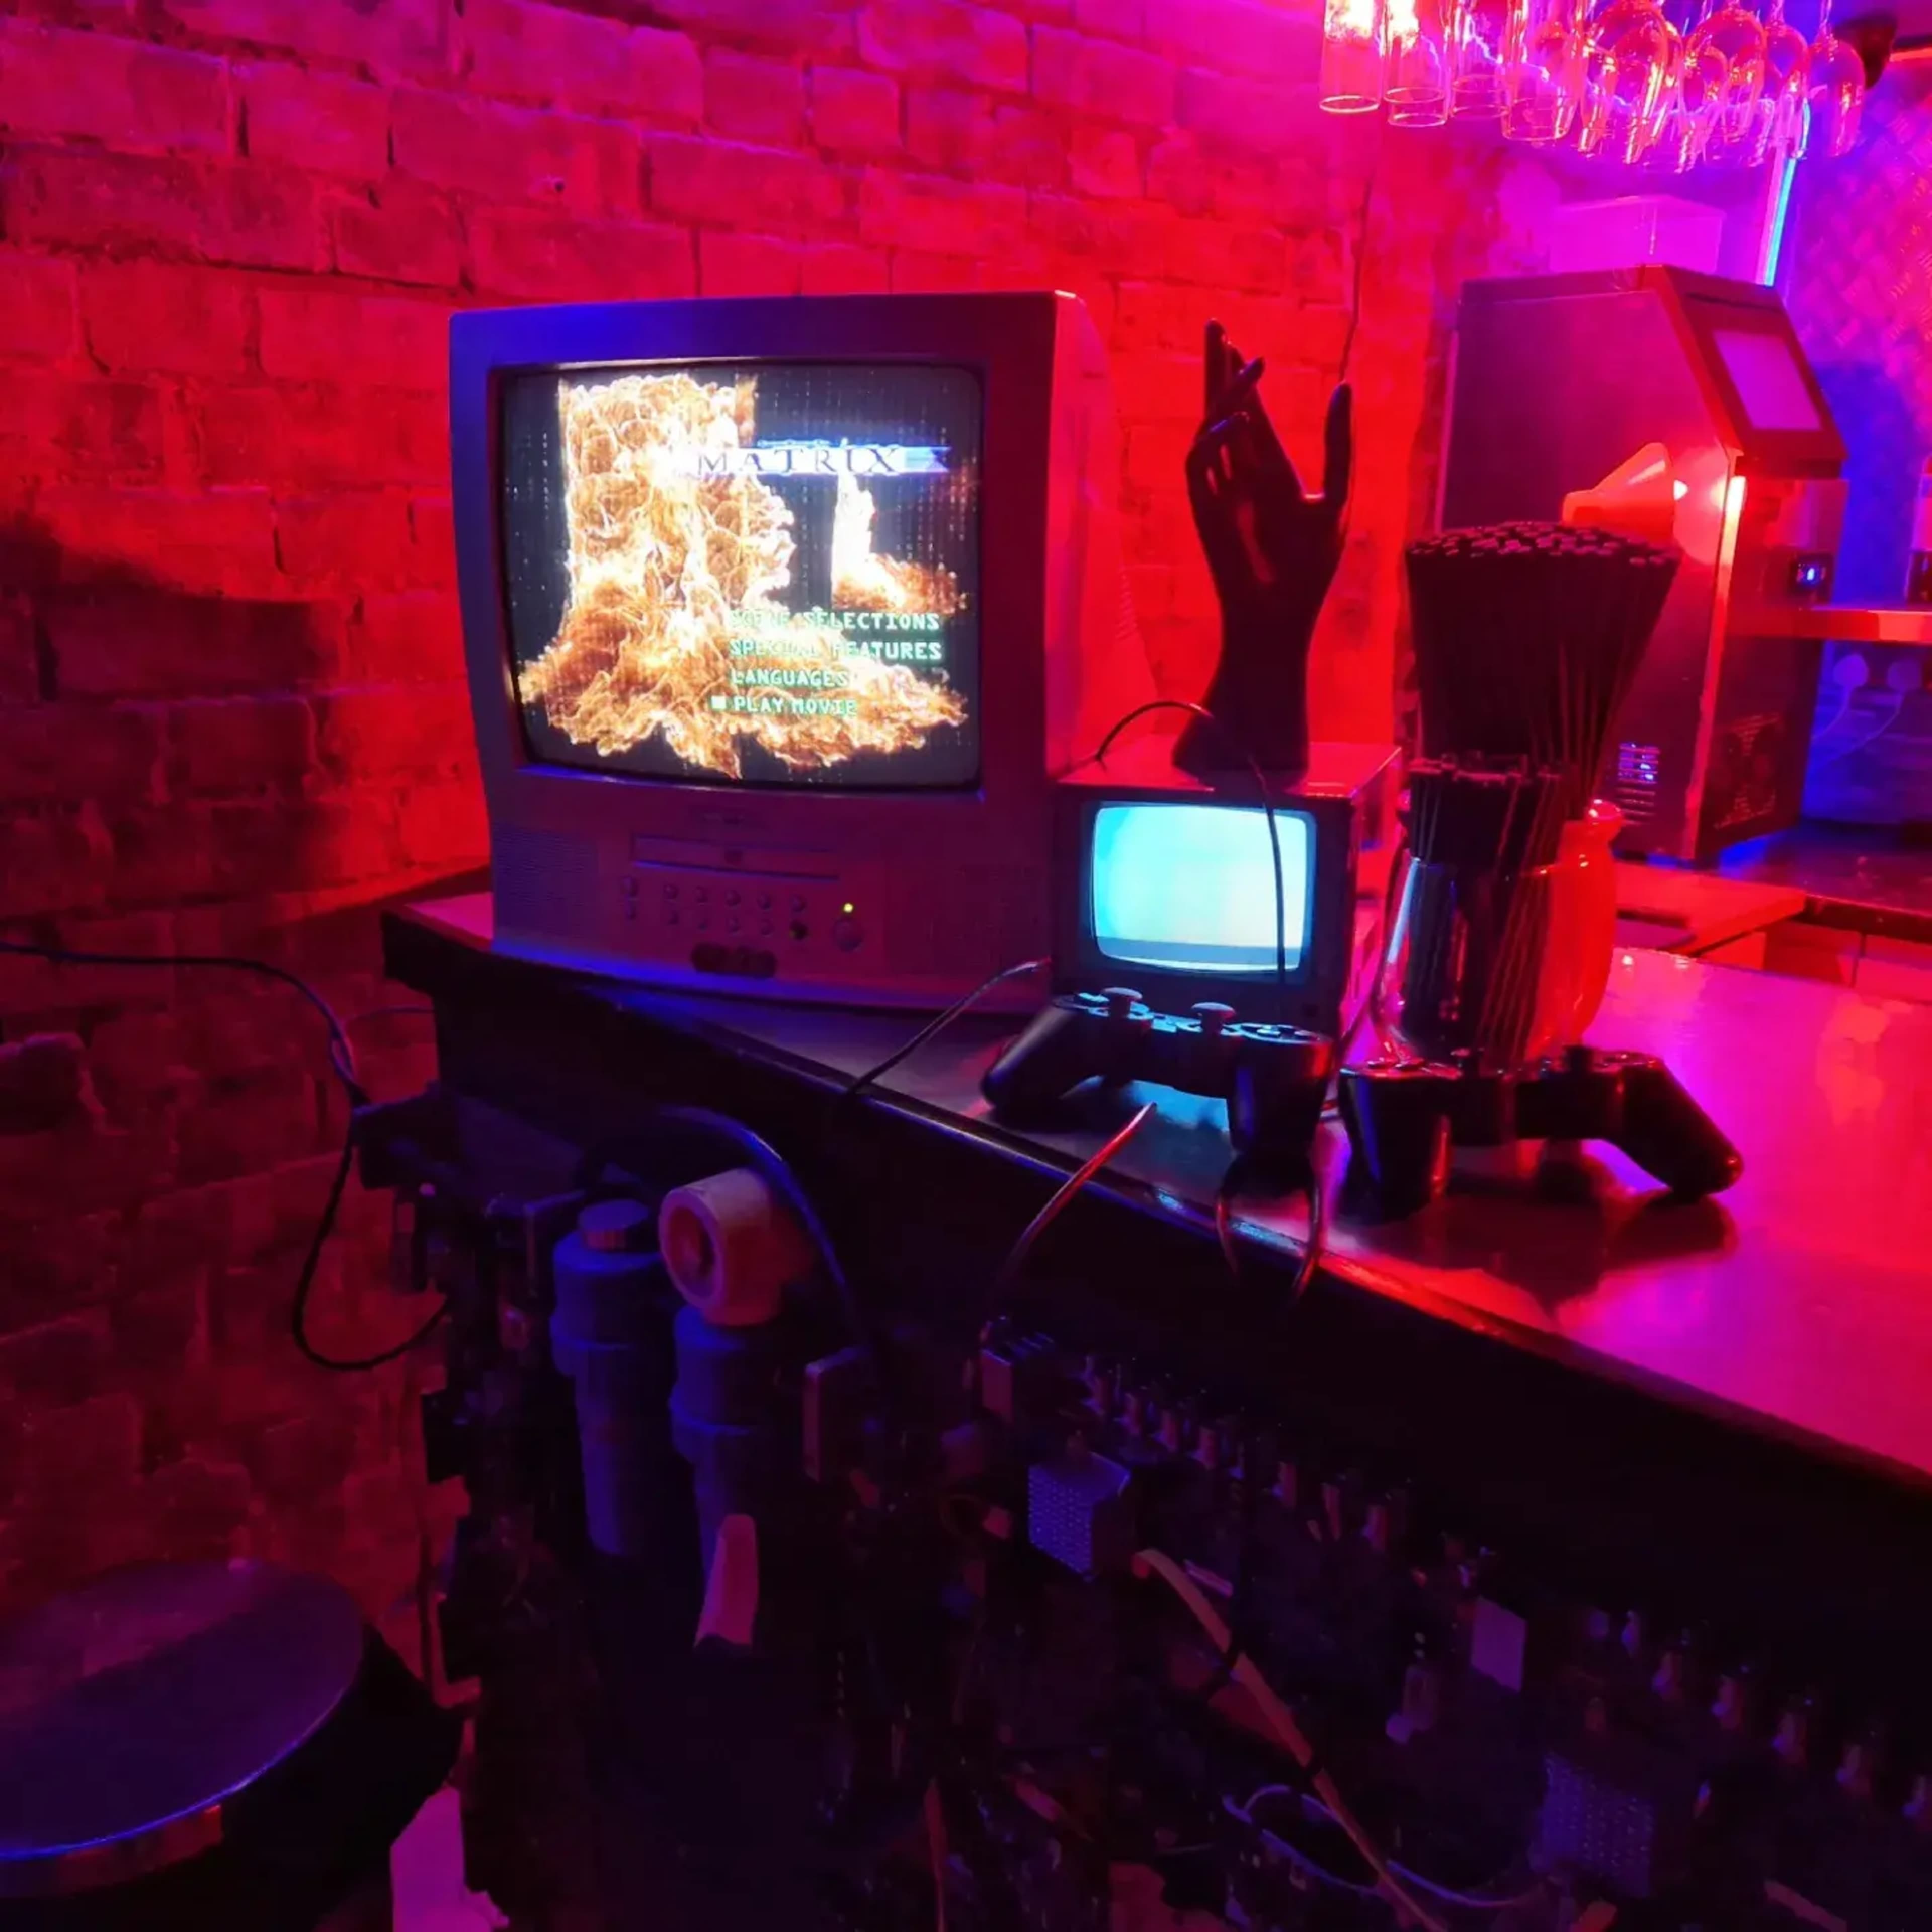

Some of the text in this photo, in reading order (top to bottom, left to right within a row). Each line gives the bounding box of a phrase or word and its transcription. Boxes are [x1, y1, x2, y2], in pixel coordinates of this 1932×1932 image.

[697, 448, 899, 474] MATRIX
[803, 611, 940, 630] SELECTIONS
[832, 640, 943, 660] FEATURES
[731, 668, 849, 688] LANGUAGES
[734, 695, 857, 716] PLAY MOVIE
